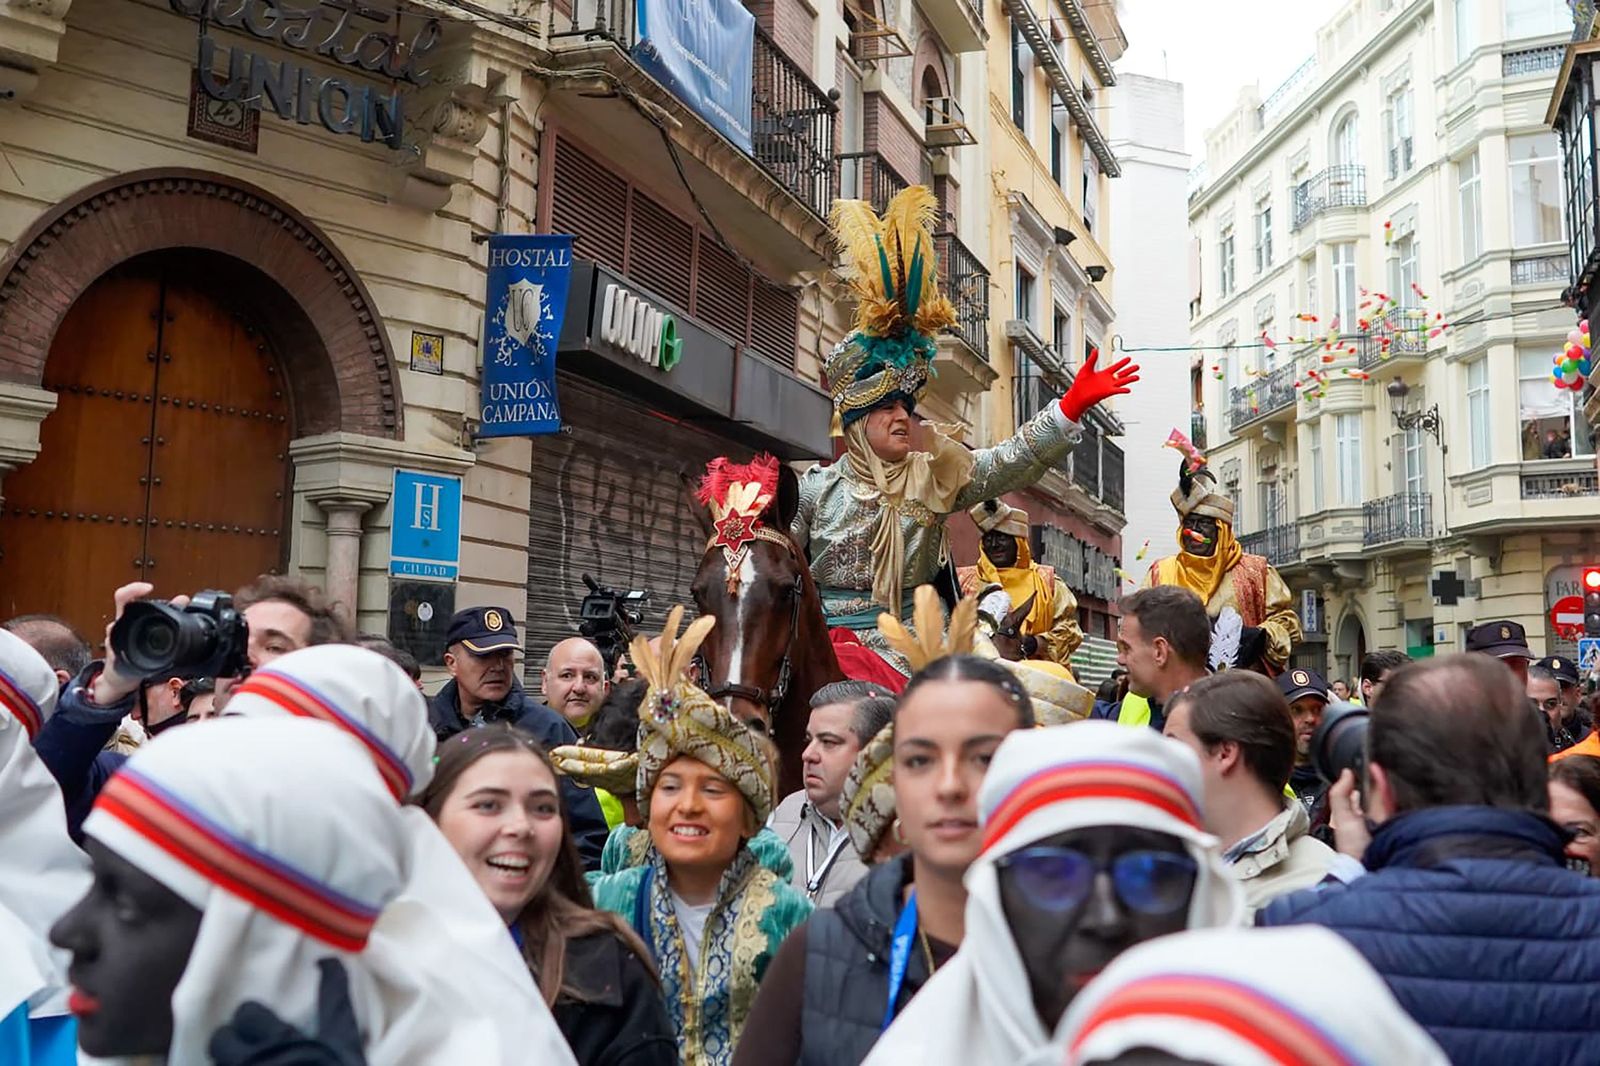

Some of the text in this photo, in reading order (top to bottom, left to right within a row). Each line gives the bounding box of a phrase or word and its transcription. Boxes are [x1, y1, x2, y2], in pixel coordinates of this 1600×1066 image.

[198, 36, 404, 150] UNION
[491, 249, 570, 267] HOSTAL
[489, 378, 553, 401] UNIÓN
[482, 403, 560, 423] CAMPANA
[402, 563, 447, 577] CIUDAD
